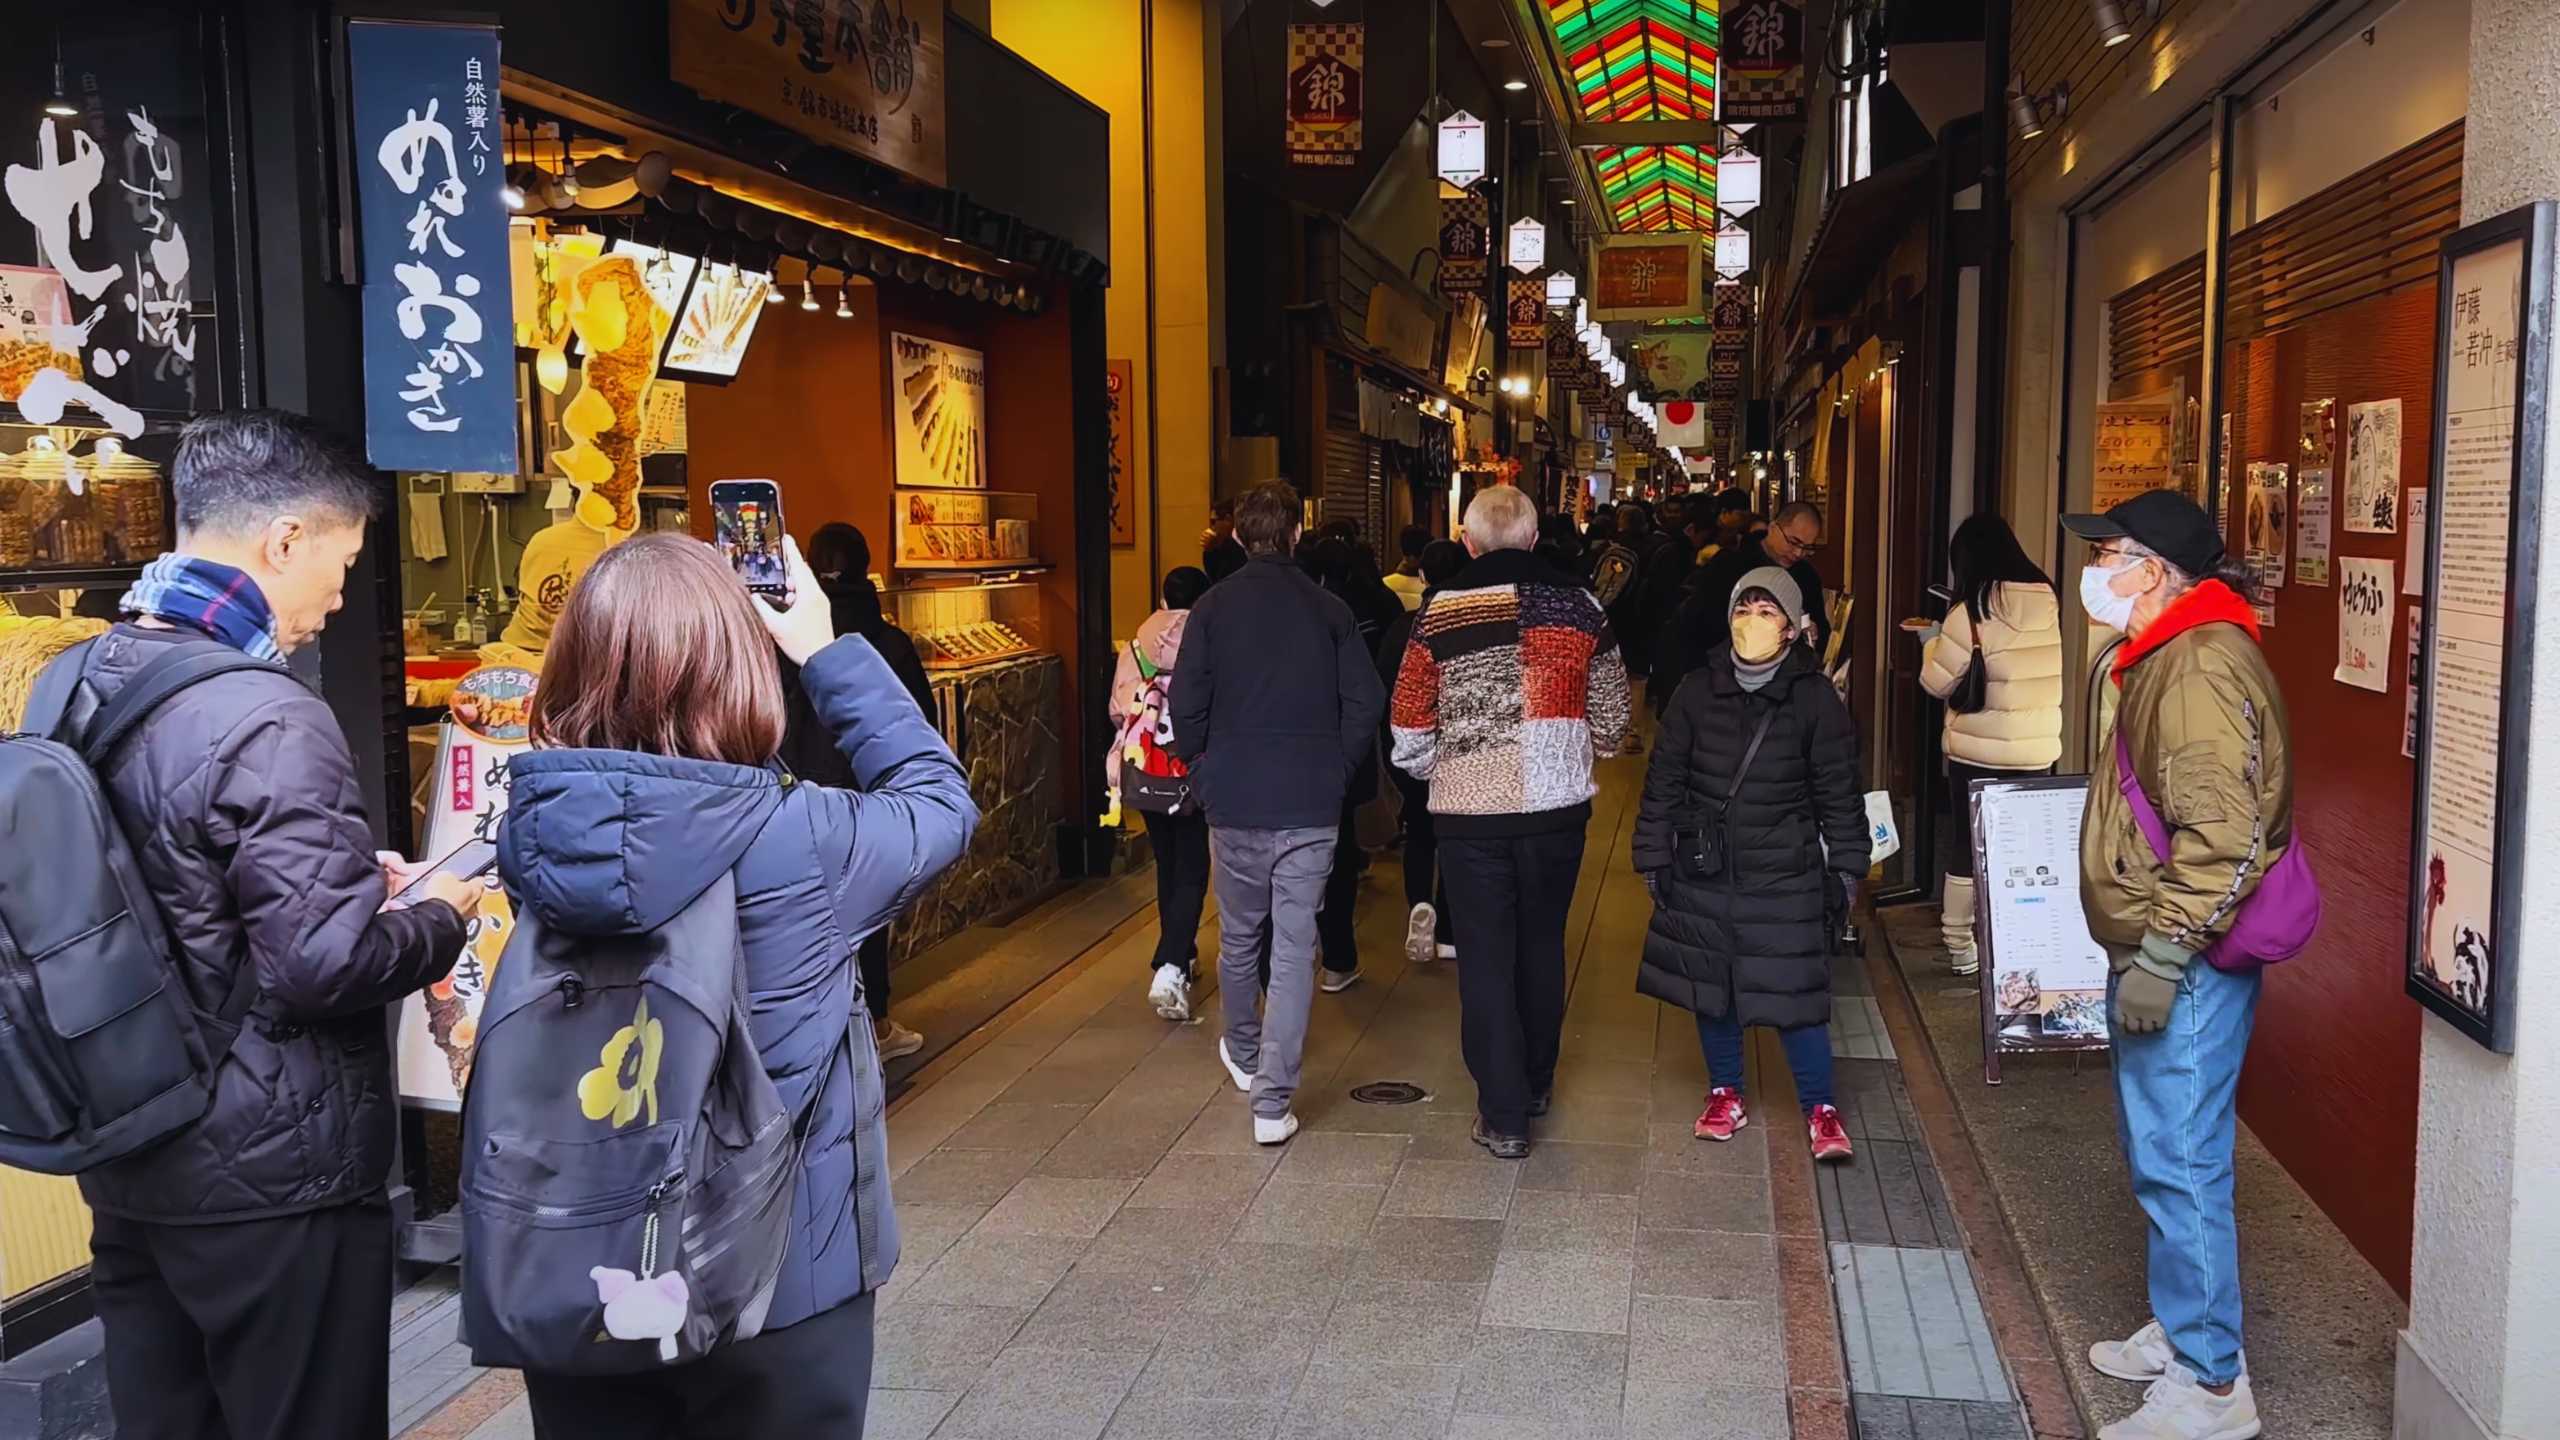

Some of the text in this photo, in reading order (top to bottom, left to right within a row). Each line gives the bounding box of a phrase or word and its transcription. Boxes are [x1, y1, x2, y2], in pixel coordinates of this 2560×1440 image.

[1734, 2, 1785, 68] 錦
[464, 57, 491, 176] 自然薯入り
[1299, 61, 1345, 121] 錦
